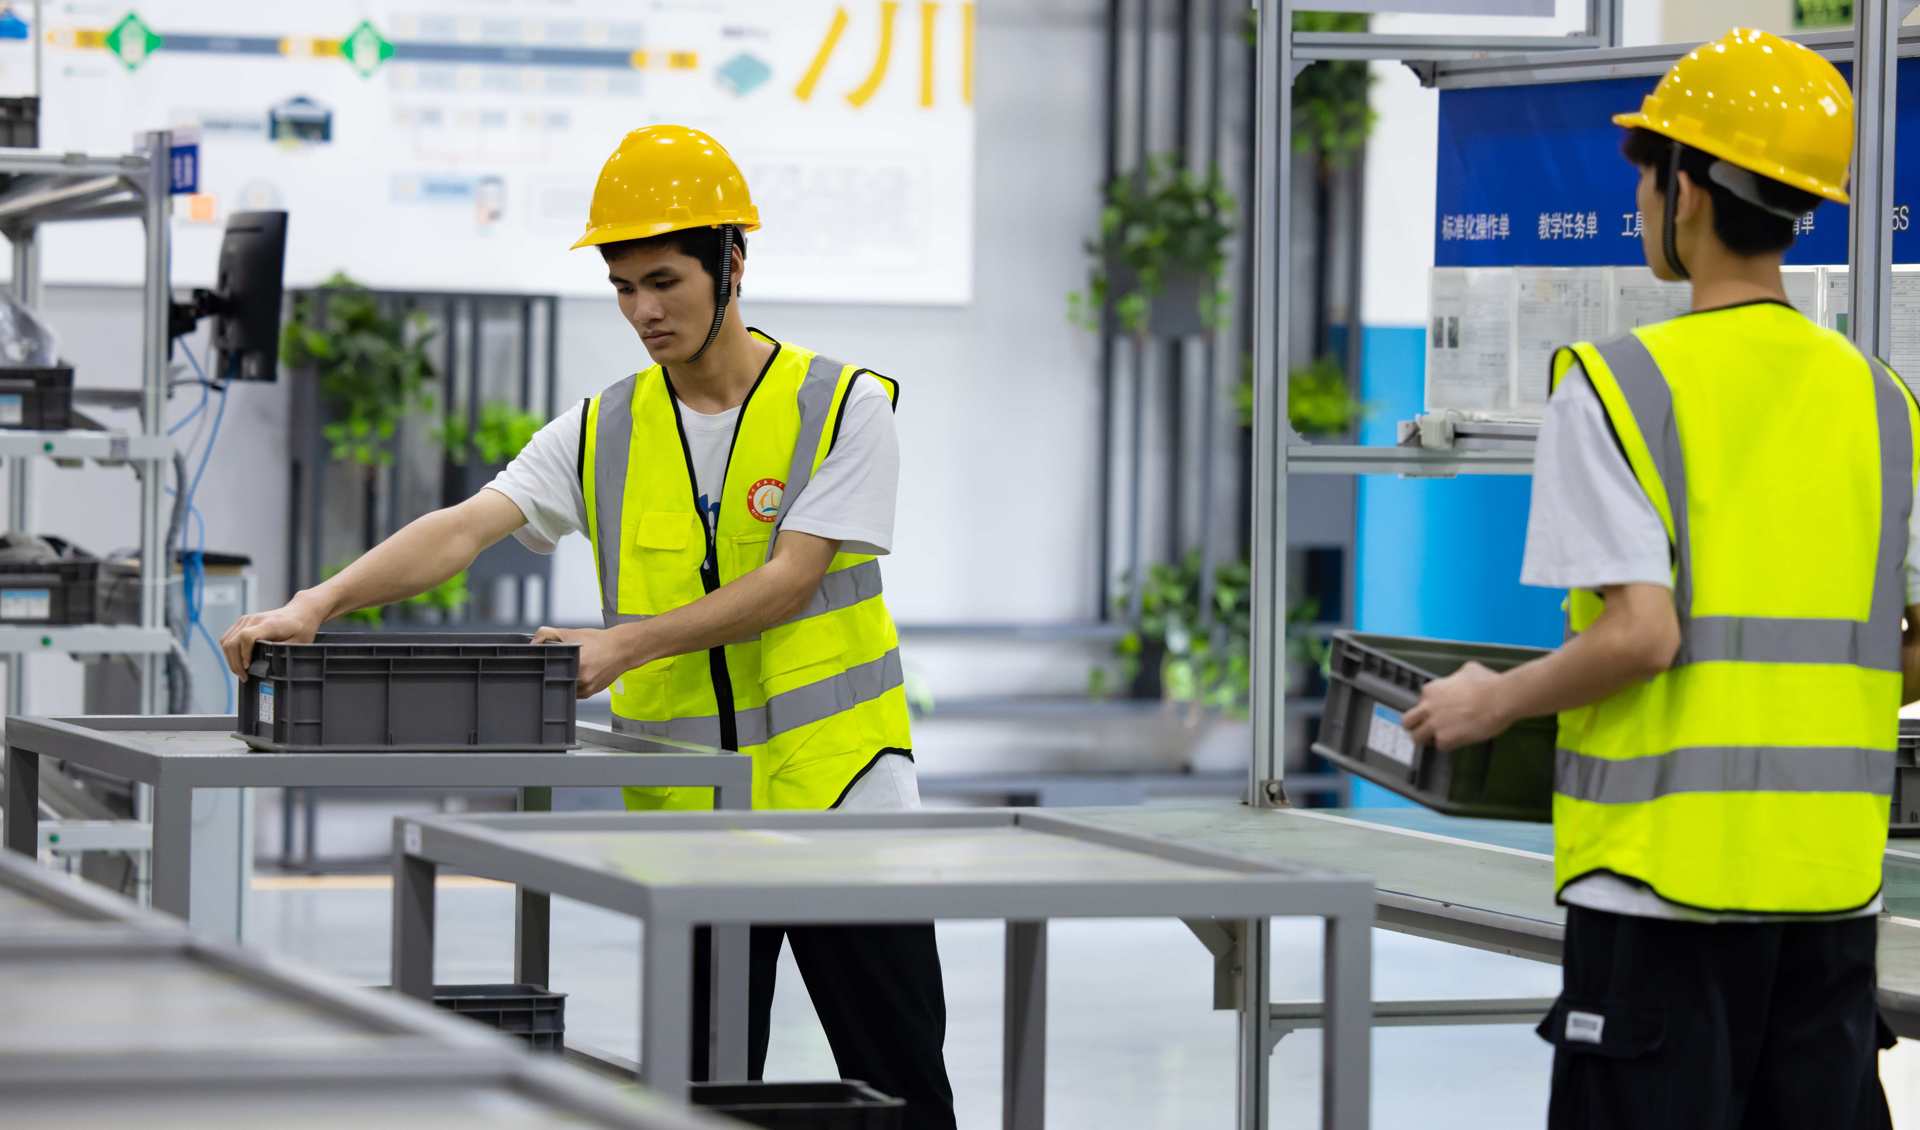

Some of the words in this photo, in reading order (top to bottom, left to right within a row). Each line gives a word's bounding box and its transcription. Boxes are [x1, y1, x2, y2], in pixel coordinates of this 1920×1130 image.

[1538, 211, 1598, 239] 教学任务单
